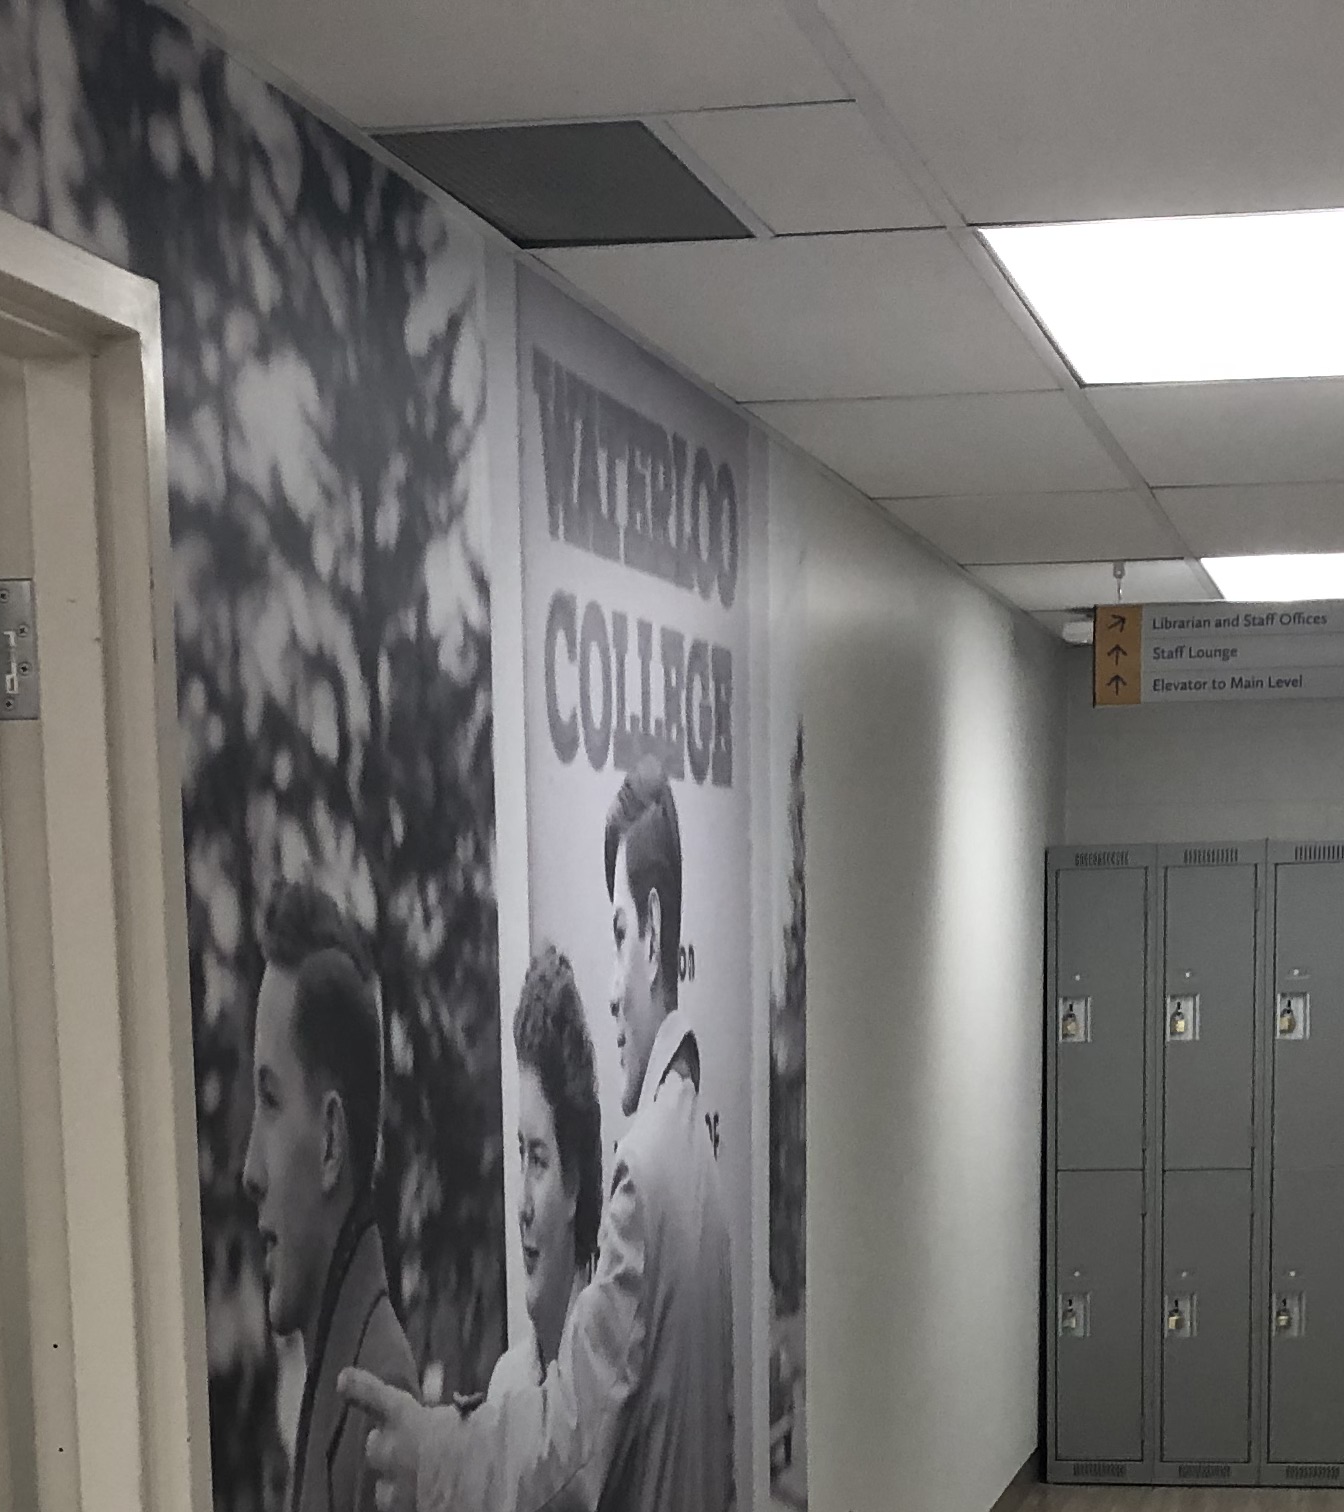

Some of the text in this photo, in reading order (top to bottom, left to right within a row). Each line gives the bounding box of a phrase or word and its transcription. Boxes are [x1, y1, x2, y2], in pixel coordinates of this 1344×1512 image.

[532, 345, 739, 609] WATERLOO
[1152, 611, 1328, 630] Librarian and Staff Offices
[1152, 644, 1238, 661] Staff Lounge
[544, 588, 733, 788] COLLEGE
[1152, 674, 1303, 692] Elevator to Main Level
